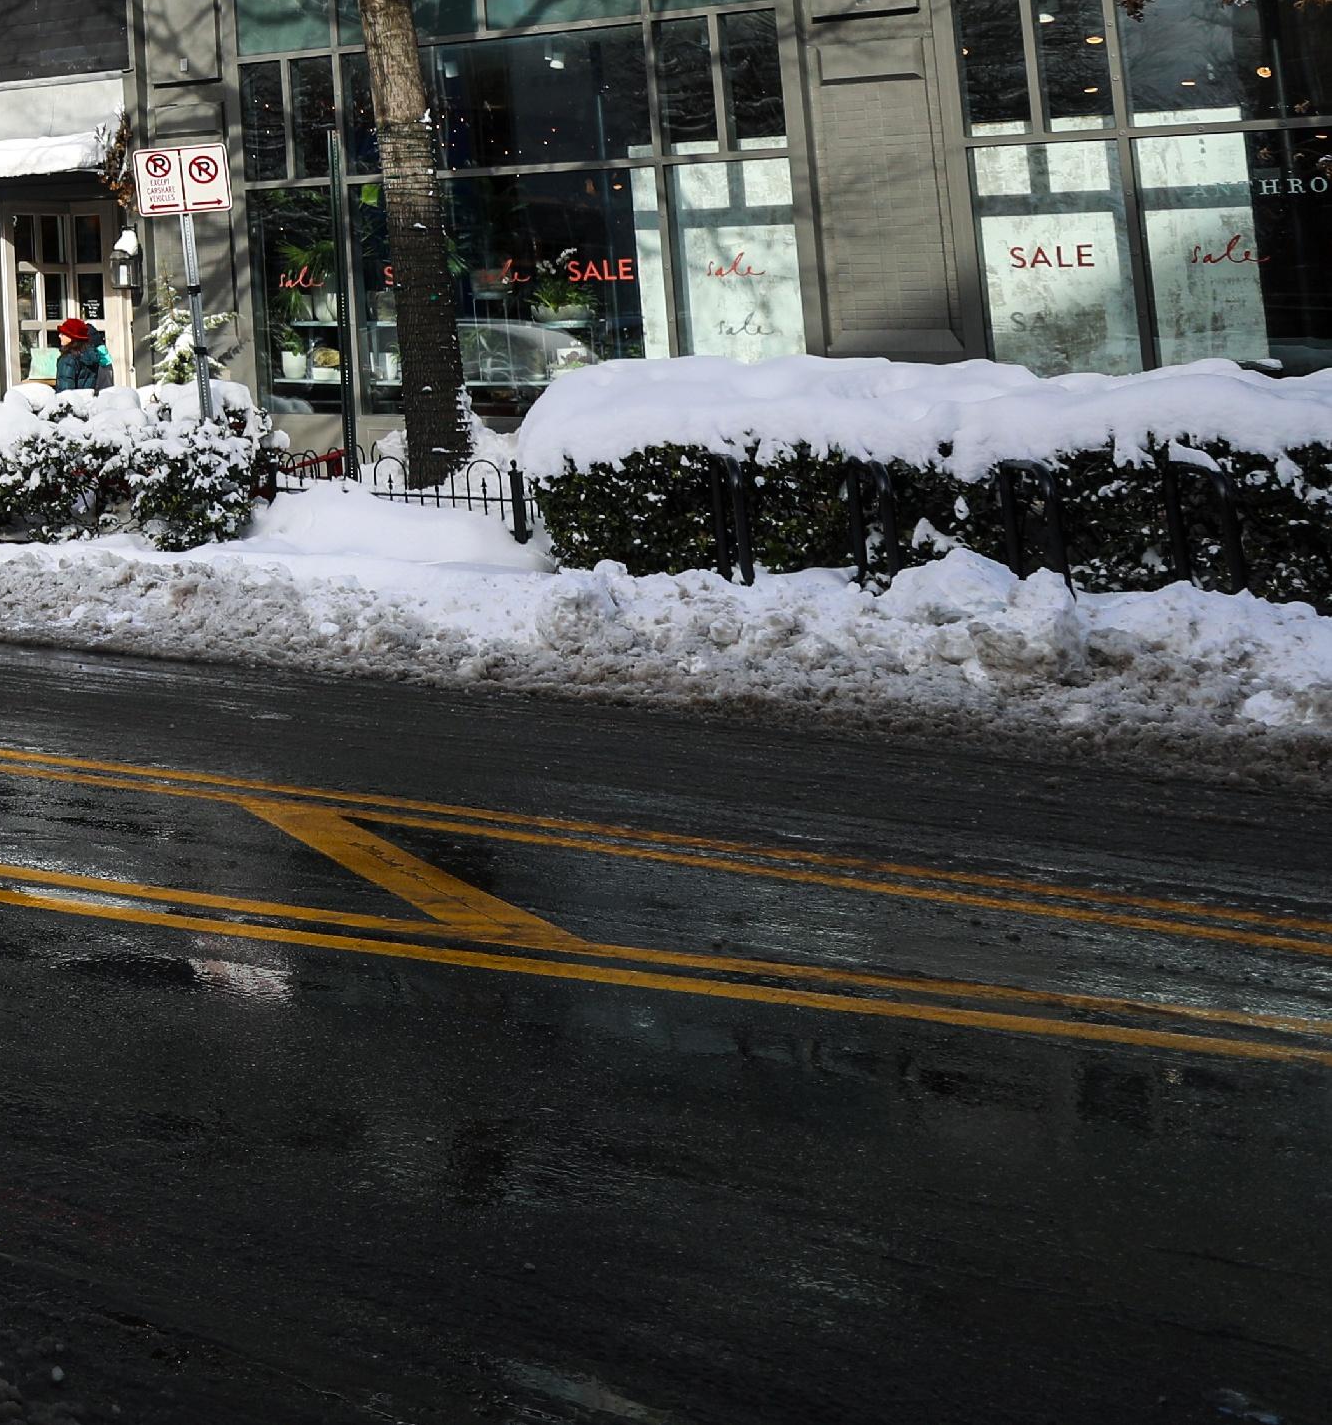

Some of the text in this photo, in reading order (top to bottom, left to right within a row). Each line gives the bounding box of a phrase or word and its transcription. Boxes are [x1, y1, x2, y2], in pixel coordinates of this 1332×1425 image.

[147, 185, 175, 195] CARSHARE
[150, 178, 170, 186] EXCEPT
[149, 193, 175, 202] VEHICLES
[1009, 244, 1095, 269] SALE
[1191, 234, 1272, 264] sale
[567, 258, 635, 282] SALE
[707, 251, 767, 277] sale
[278, 265, 325, 288] sale
